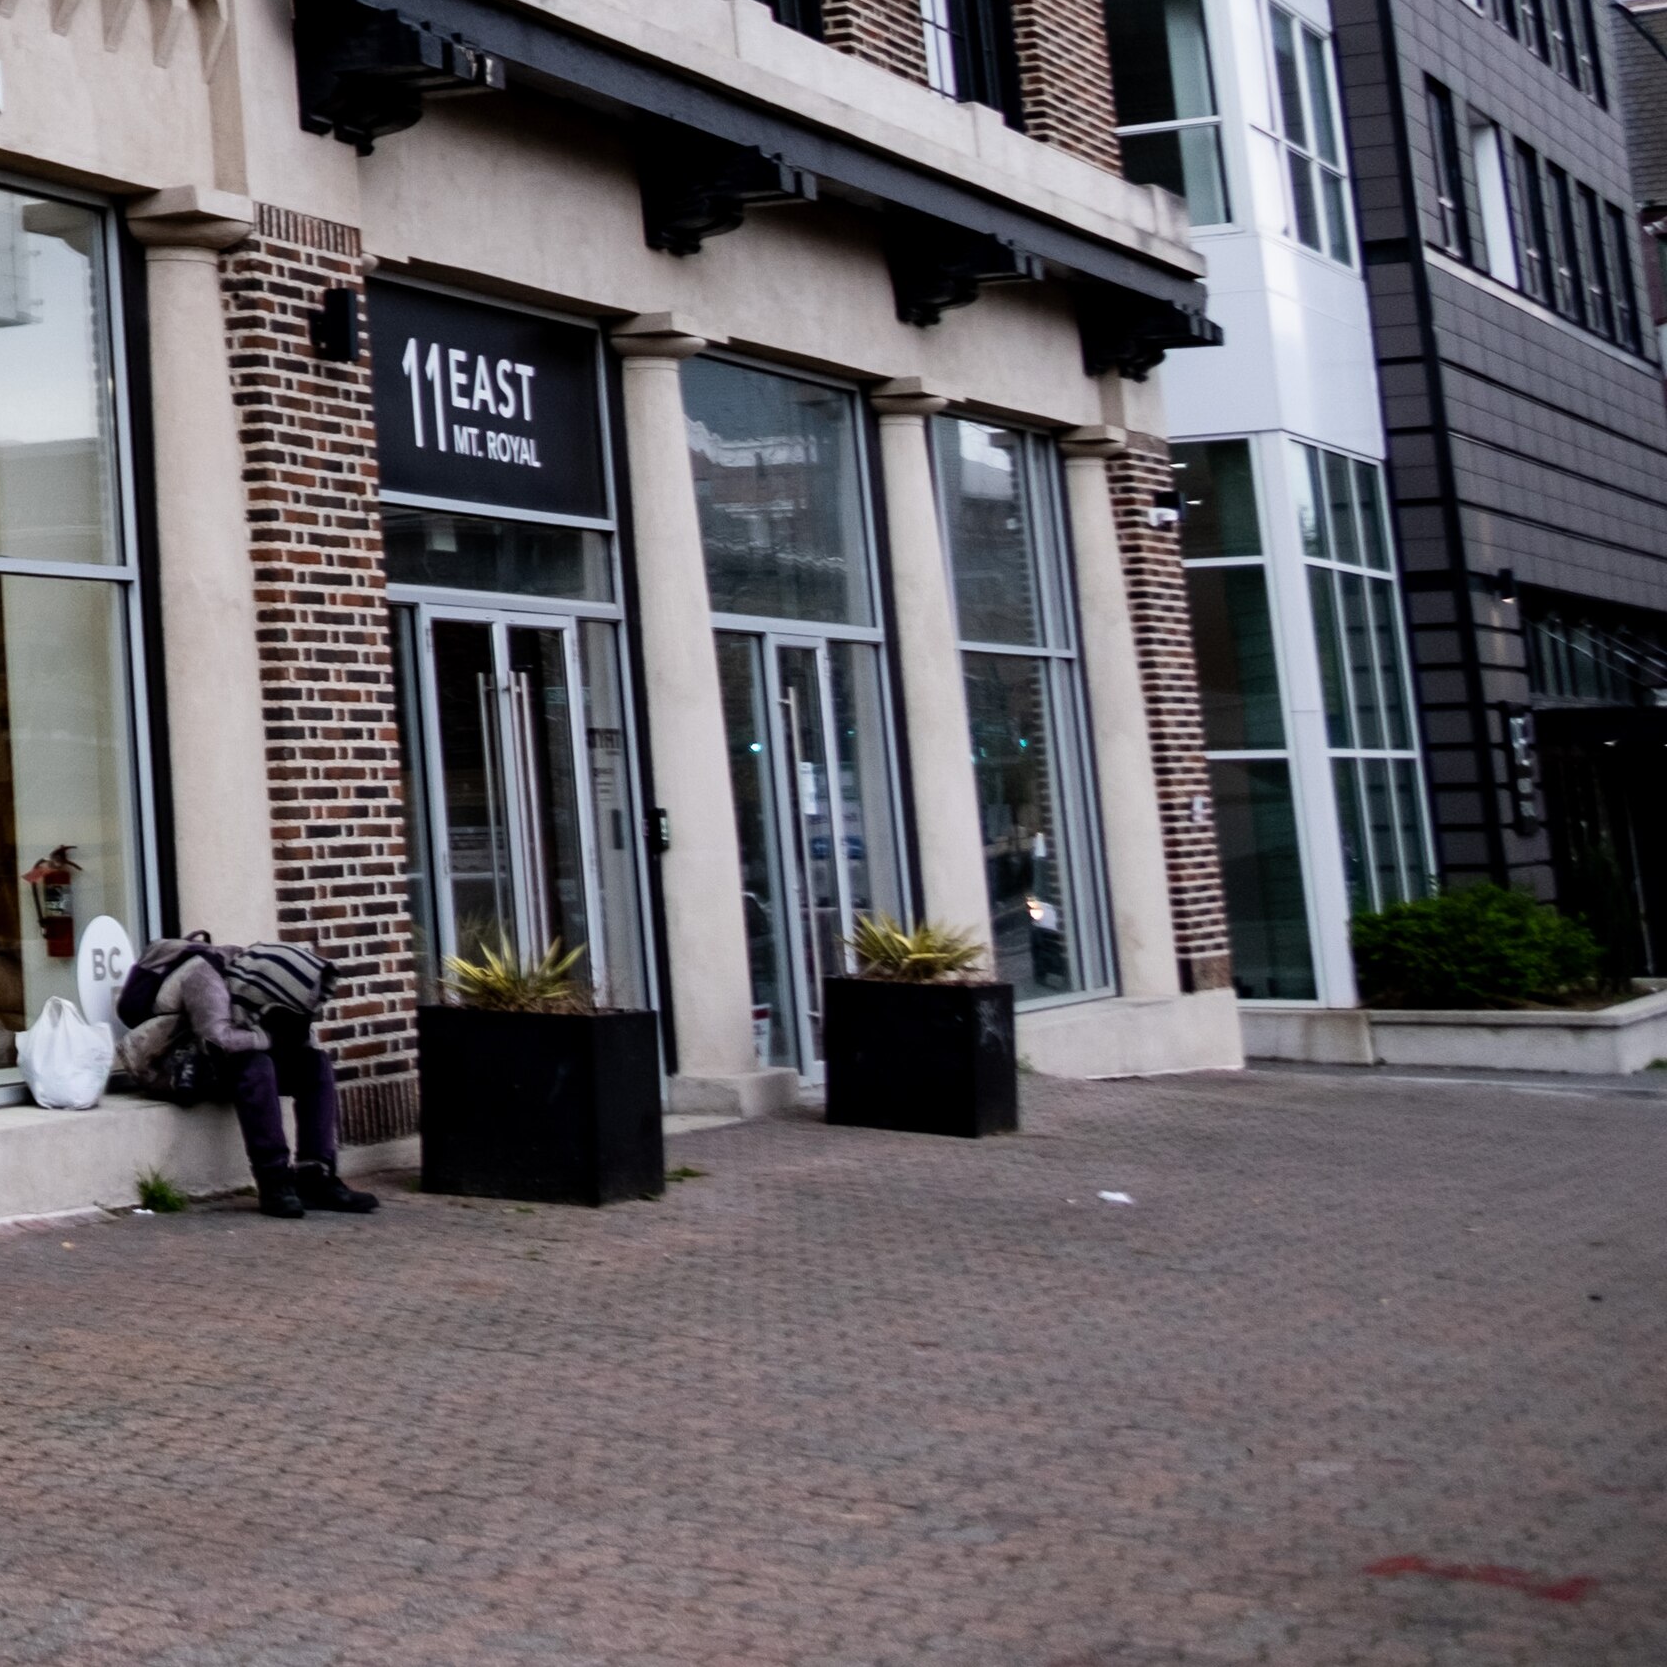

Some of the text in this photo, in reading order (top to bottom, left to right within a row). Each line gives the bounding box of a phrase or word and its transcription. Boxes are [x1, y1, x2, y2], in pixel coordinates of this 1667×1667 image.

[402, 337, 536, 453] 11 EAST
[453, 424, 542, 468] MT. ROYAL
[91, 946, 123, 982] BC
